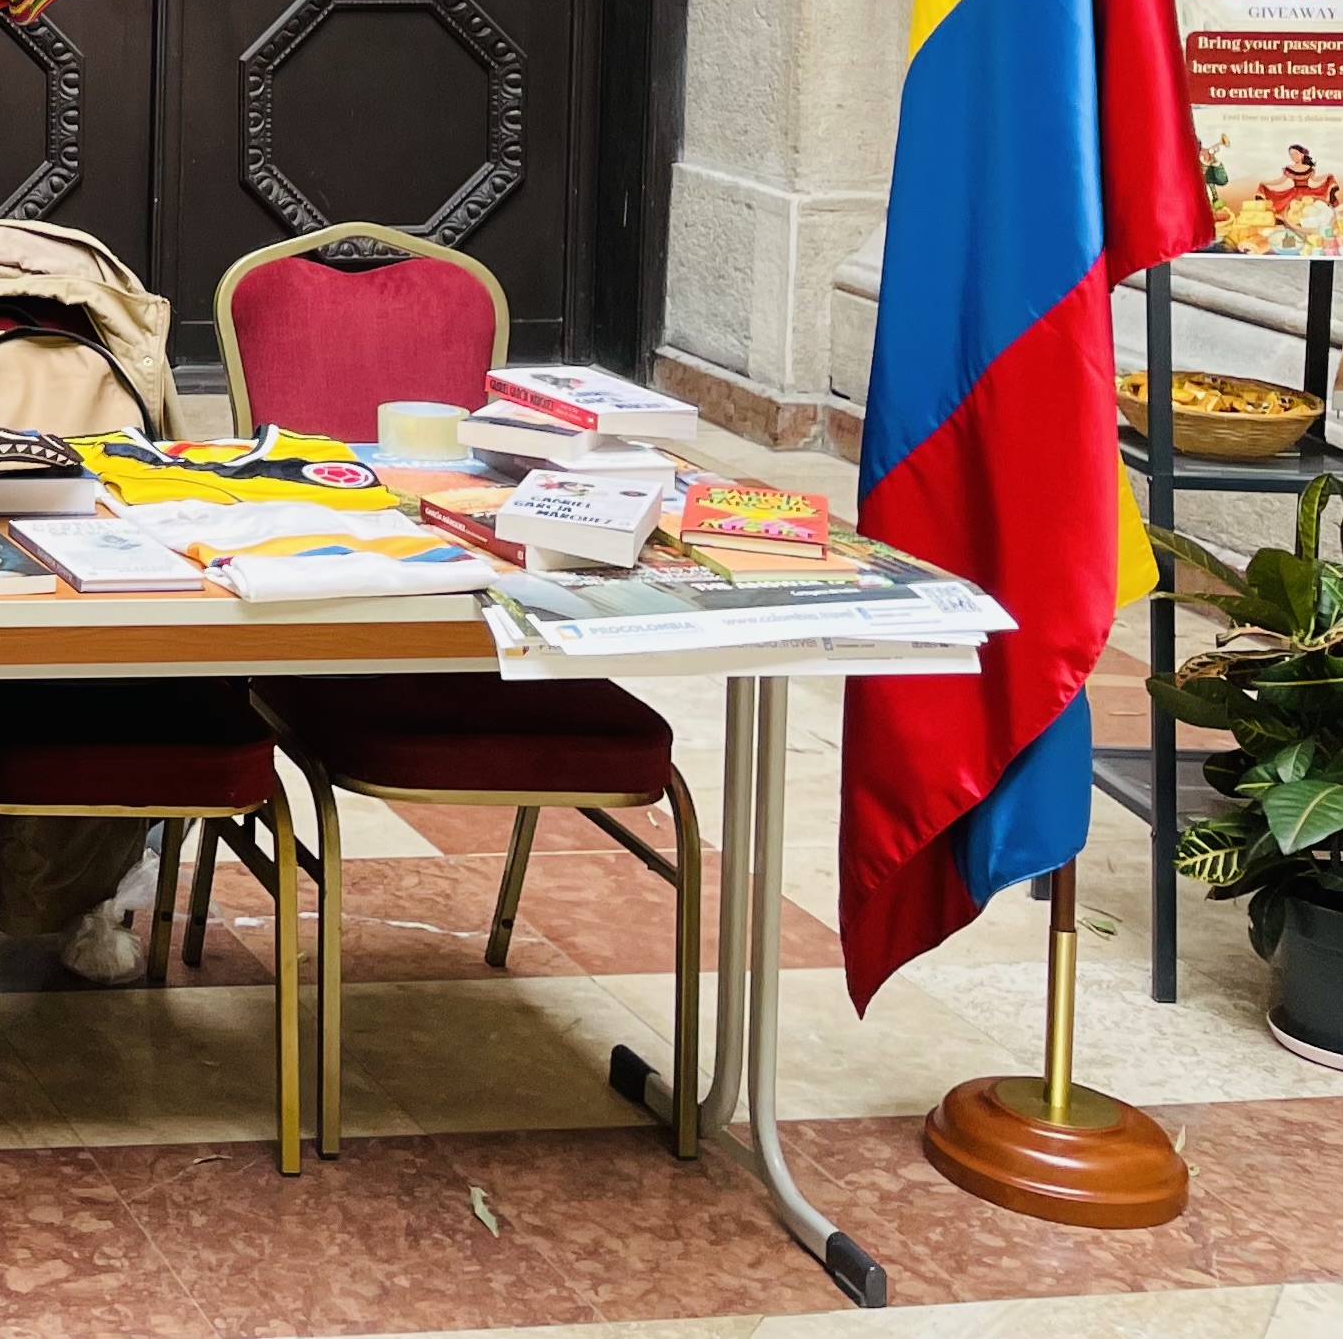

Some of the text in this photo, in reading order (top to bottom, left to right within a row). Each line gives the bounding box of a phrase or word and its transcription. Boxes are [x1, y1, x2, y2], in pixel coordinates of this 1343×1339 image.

[1248, 7, 1336, 20] GIVEAWAY
[1198, 36, 1241, 51] Bring
[1243, 39, 1280, 52] your
[1192, 60, 1227, 74] here
[1230, 60, 1265, 74] with
[1268, 63, 1282, 75] at
[1287, 61, 1323, 75] least
[1326, 63, 1336, 76] 5
[1210, 86, 1343, 102] to enter the givea
